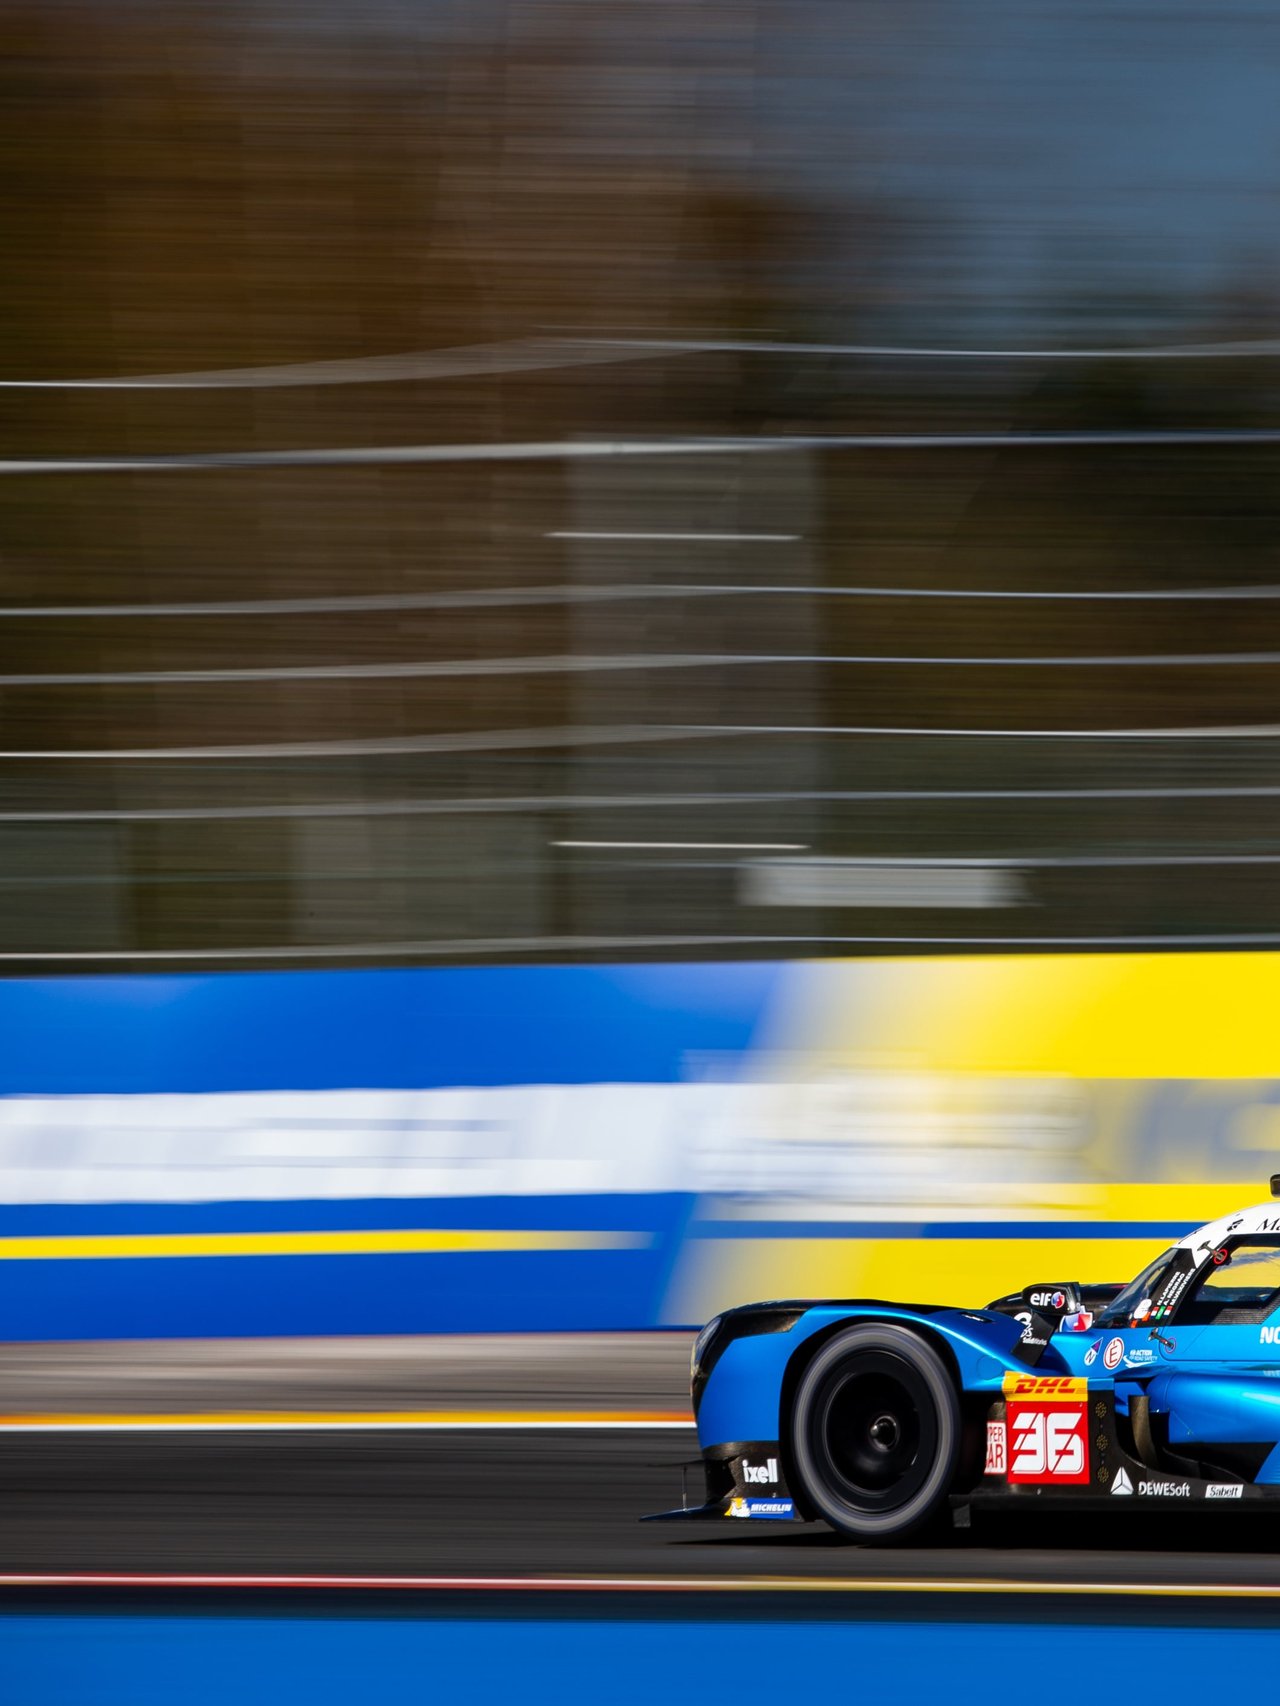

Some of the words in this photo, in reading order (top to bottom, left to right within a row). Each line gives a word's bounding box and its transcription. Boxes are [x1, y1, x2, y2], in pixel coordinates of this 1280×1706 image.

[1030, 1292, 1052, 1306] elf
[1015, 1378, 1076, 1393] DHL
[988, 1426, 1003, 1442] PER
[1011, 1412, 1084, 1474] 36
[986, 1444, 1003, 1468] AR
[742, 1458, 778, 1483] ixell
[1138, 1481, 1190, 1497] DEWESoft
[751, 1504, 793, 1512] MICHELIN
